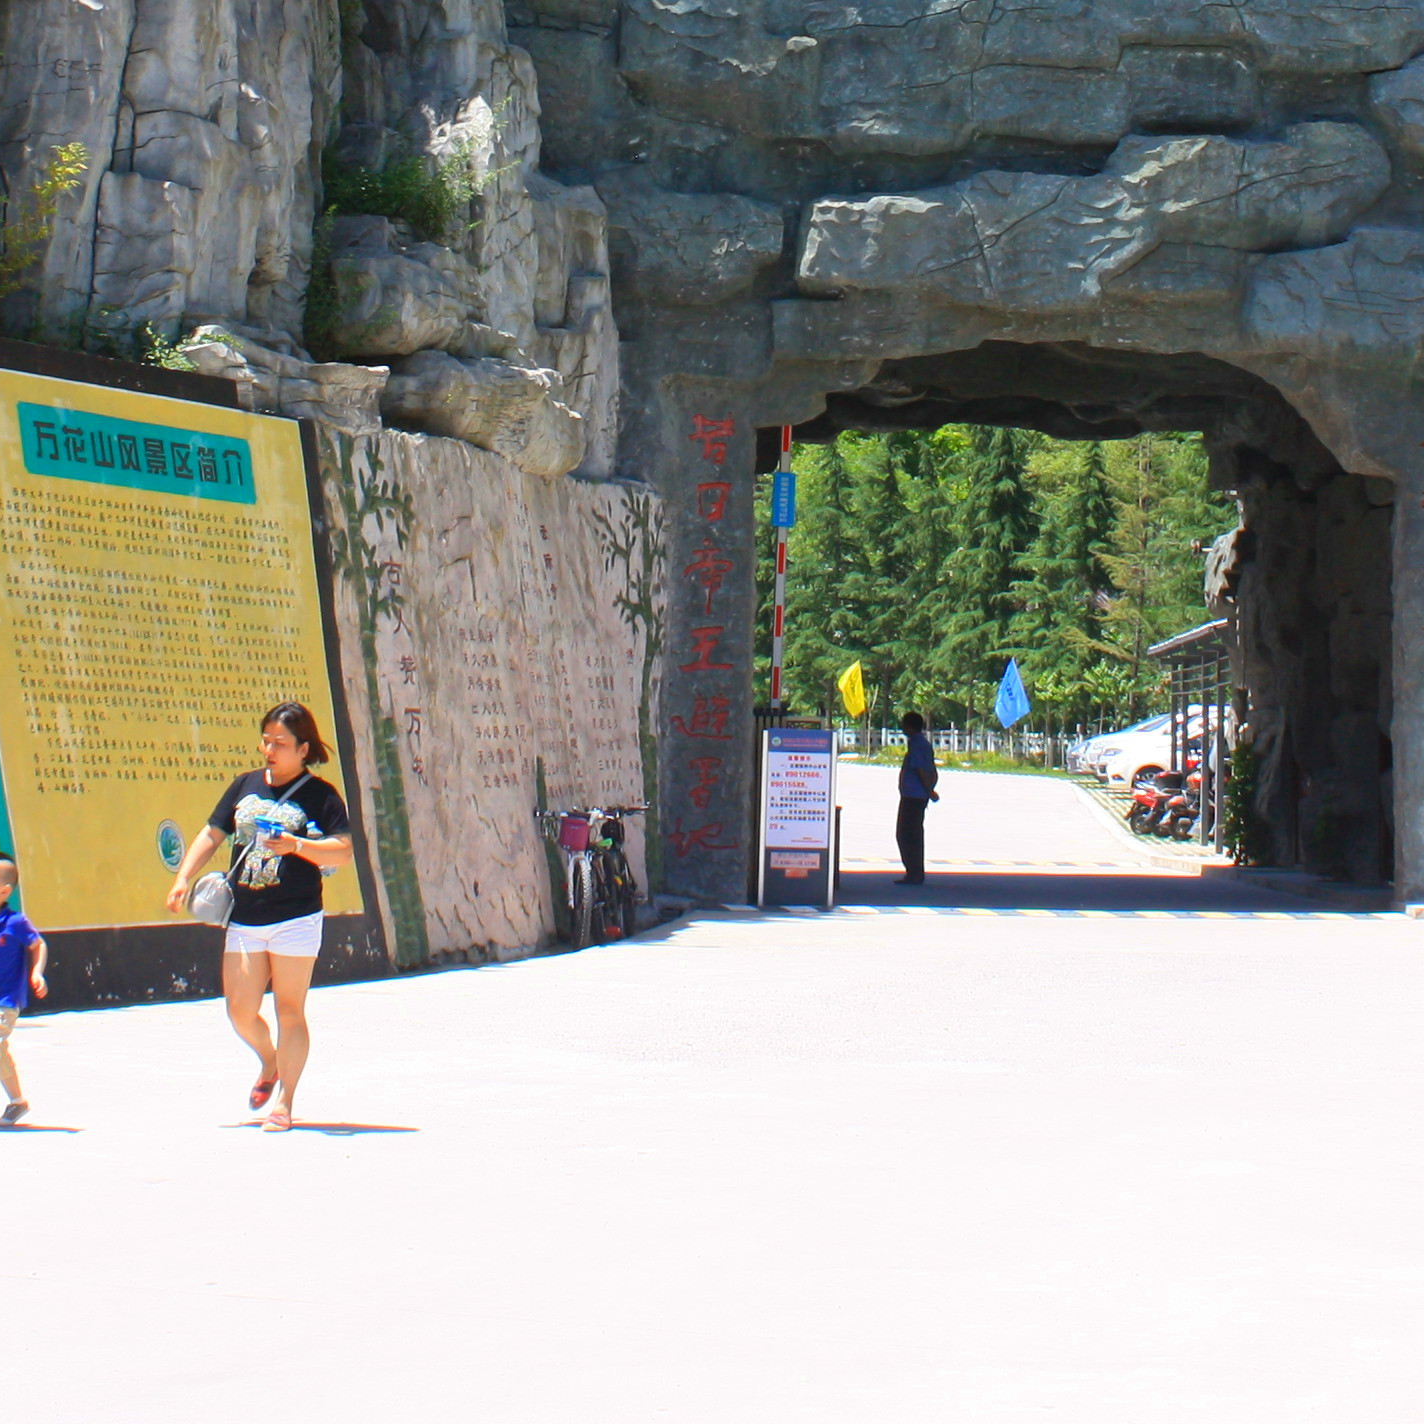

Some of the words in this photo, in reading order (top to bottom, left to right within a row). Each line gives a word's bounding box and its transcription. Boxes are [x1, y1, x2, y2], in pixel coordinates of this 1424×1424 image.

[33, 421, 243, 486] 万花山风景区简介
[668, 413, 739, 857] 昔日帝王避暑地
